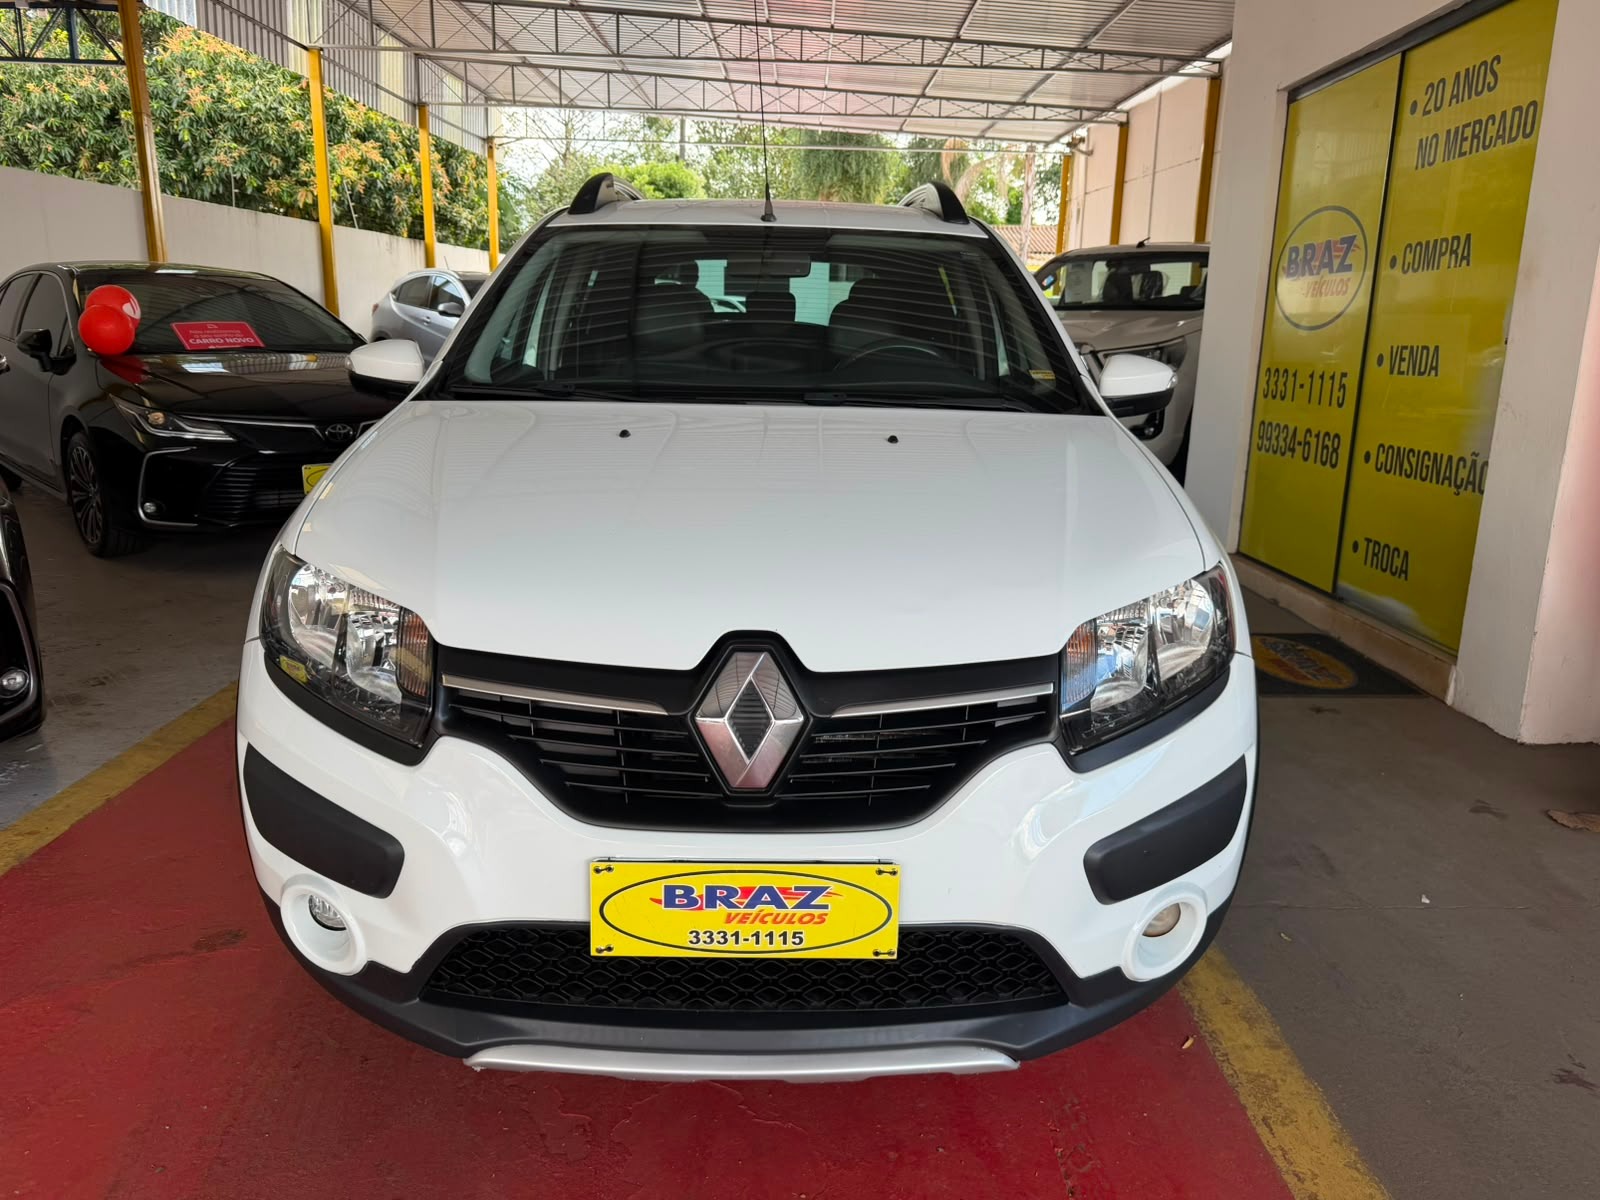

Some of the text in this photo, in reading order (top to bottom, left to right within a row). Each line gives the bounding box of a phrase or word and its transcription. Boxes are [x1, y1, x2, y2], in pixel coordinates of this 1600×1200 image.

[1422, 55, 1501, 116] 20 ANOS
[1415, 100, 1538, 170] NO MERCADO
[1286, 234, 1357, 279] BRAZ
[1401, 233, 1471, 275] COMPRA
[1303, 276, 1351, 298] VEÍCULOS
[1388, 345, 1439, 377] VENDA
[1262, 367, 1348, 408] 3331-1115
[1256, 420, 1341, 469] 99334-6168
[1363, 537, 1410, 581] TROCA
[663, 884, 831, 910] BRAZ
[723, 910, 828, 925] VEÍCULOS
[688, 929, 805, 945] 3331-1115
